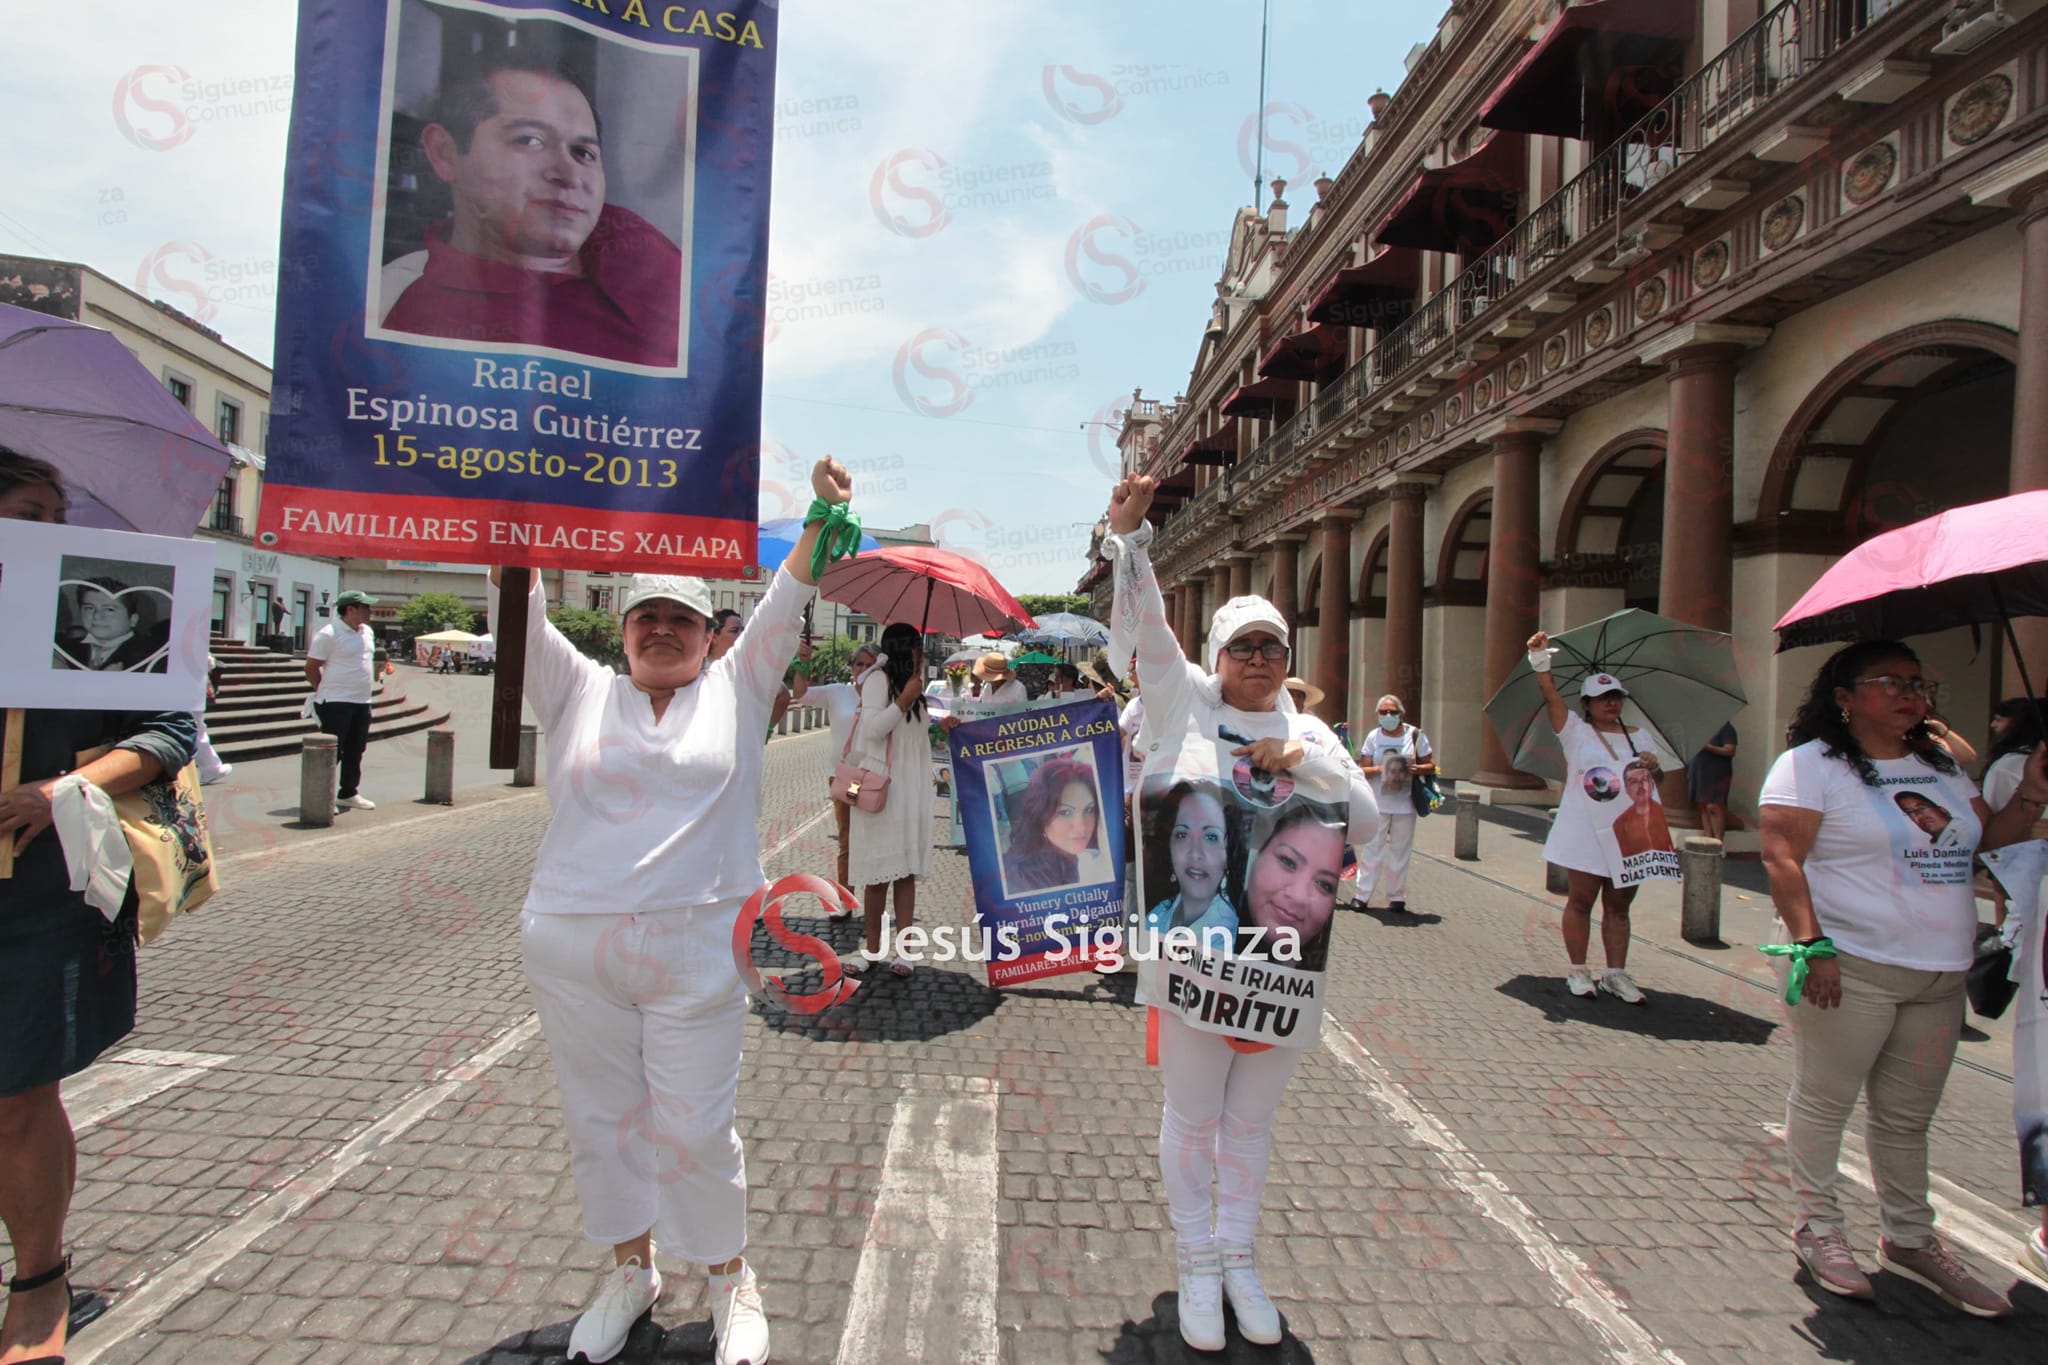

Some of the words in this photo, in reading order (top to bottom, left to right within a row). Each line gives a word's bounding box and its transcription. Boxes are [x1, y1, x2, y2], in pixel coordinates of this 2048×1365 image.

[620, 0, 651, 27] A
[662, 4, 764, 49] CASA
[472, 357, 593, 401] Rafael
[346, 387, 519, 432] Espinosa
[533, 405, 703, 451] Gutiérrez
[373, 433, 680, 489] 15-agosto-2013
[281, 506, 479, 543] FAMILIARES
[489, 520, 625, 553] ENLACES
[635, 531, 744, 561] XALAPA
[242, 549, 282, 575] BBVA
[960, 745, 972, 758] A
[974, 731, 1057, 756] REGRESAR
[1060, 731, 1072, 741] A
[1074, 719, 1116, 738] CASA
[998, 713, 1070, 737] AYÚDALA
[1622, 851, 1679, 869] MARGARITO
[1904, 848, 1929, 859] Luis
[1620, 867, 1646, 884] DÍAZ
[1015, 897, 1061, 914] Yunery
[1064, 887, 1109, 906] Citlally
[994, 958, 1058, 981] FAMILIARES
[1220, 961, 1236, 982] E
[1240, 966, 1315, 999] IRIANA
[1168, 973, 1300, 1038] ESPIRÍTU
